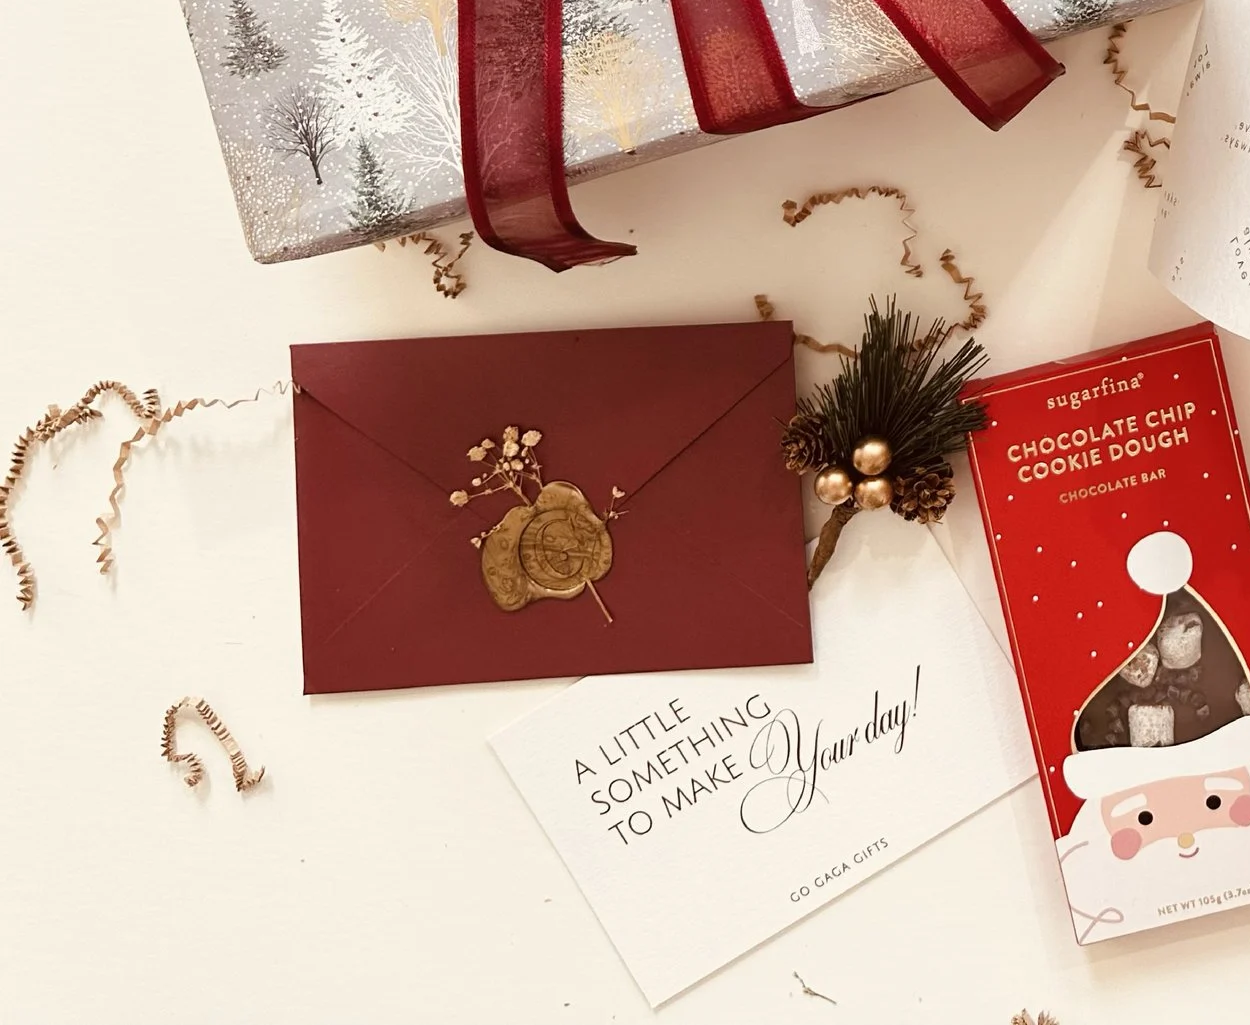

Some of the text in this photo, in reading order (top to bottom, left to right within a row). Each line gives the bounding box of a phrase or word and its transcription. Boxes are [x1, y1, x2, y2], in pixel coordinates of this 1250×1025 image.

[1007, 401, 1196, 463] CHOCOLATE CHIP
[1017, 426, 1189, 483] COOKIE DOUGH
[1059, 467, 1167, 505] CHOCOLATE BAR
[574, 697, 691, 785] A LITTLE
[591, 694, 771, 816] SOMETHING
[607, 664, 921, 846] TO MAKE Your day!
[789, 837, 890, 903] GO GAGA GIFTS
[1157, 903, 1179, 916] NET
[1180, 899, 1197, 911] WT
[1198, 895, 1222, 906] 105g
